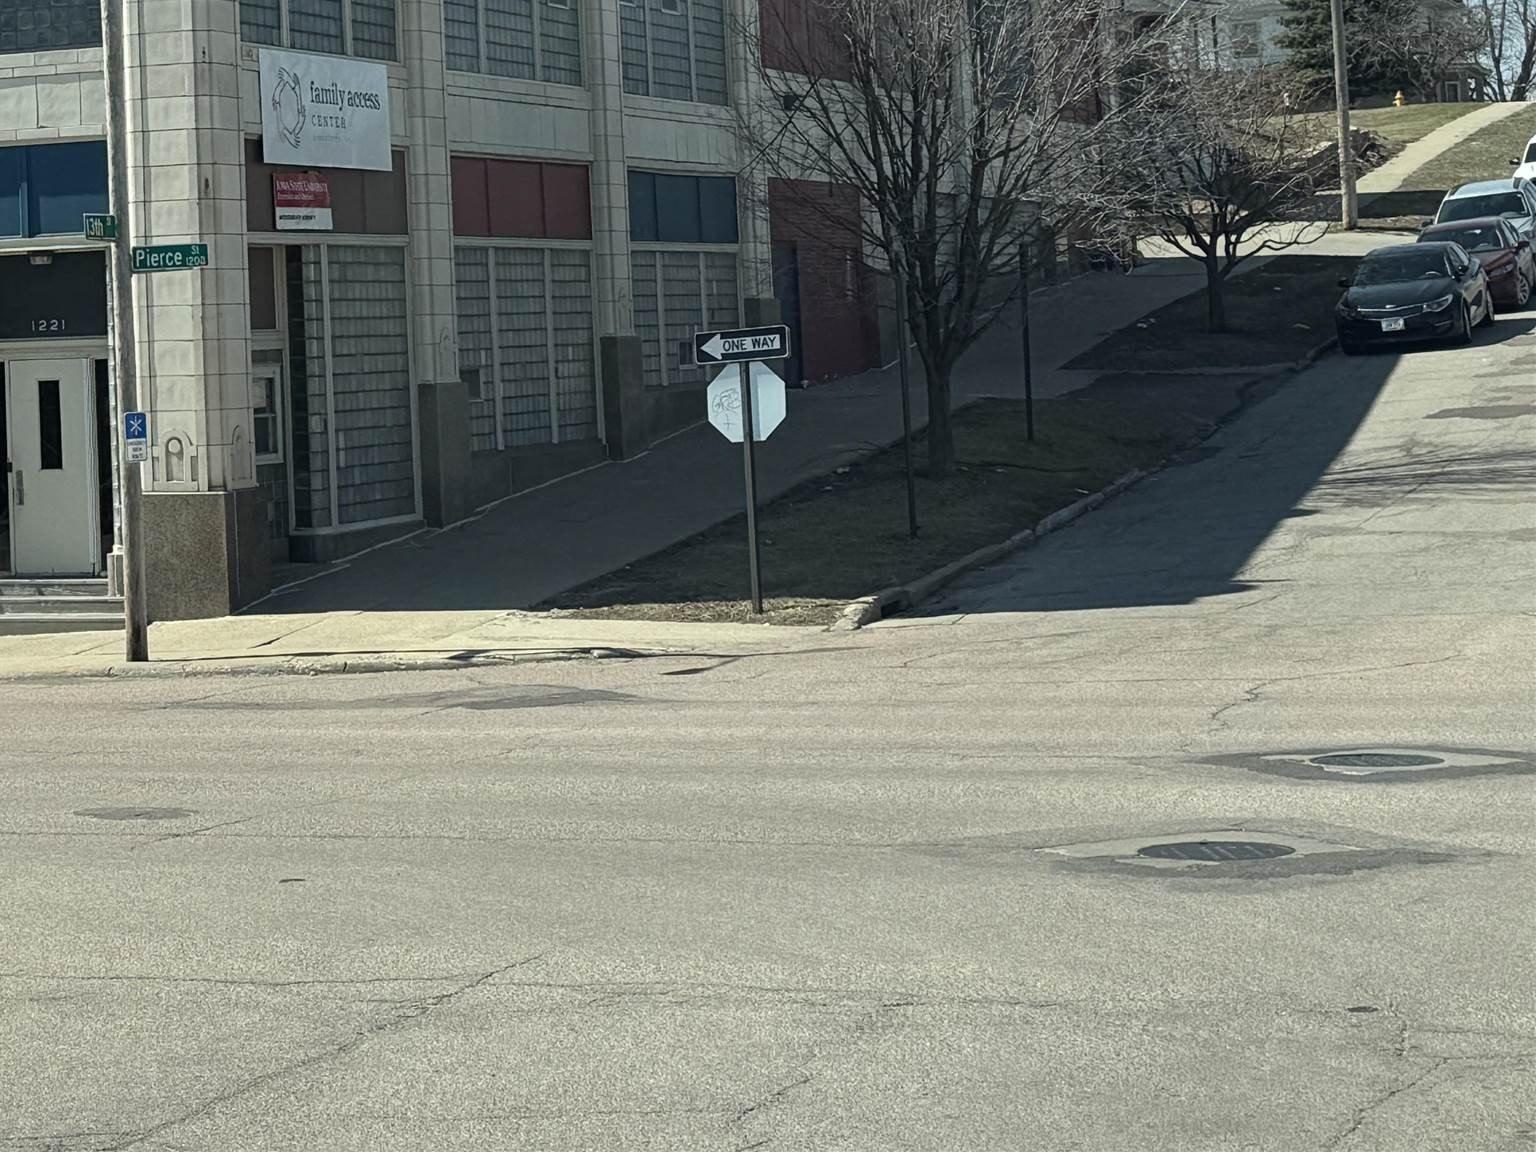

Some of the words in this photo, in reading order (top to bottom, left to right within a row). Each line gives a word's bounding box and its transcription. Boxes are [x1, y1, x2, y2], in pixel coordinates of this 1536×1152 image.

[310, 81, 345, 111] family
[347, 91, 380, 110] access
[312, 114, 346, 128] CENTER
[86, 217, 104, 236] 13th
[136, 249, 183, 267] Pierce
[191, 245, 200, 254] St
[31, 319, 65, 332] 1221
[722, 339, 748, 352] ONE
[751, 336, 776, 349] WAY
